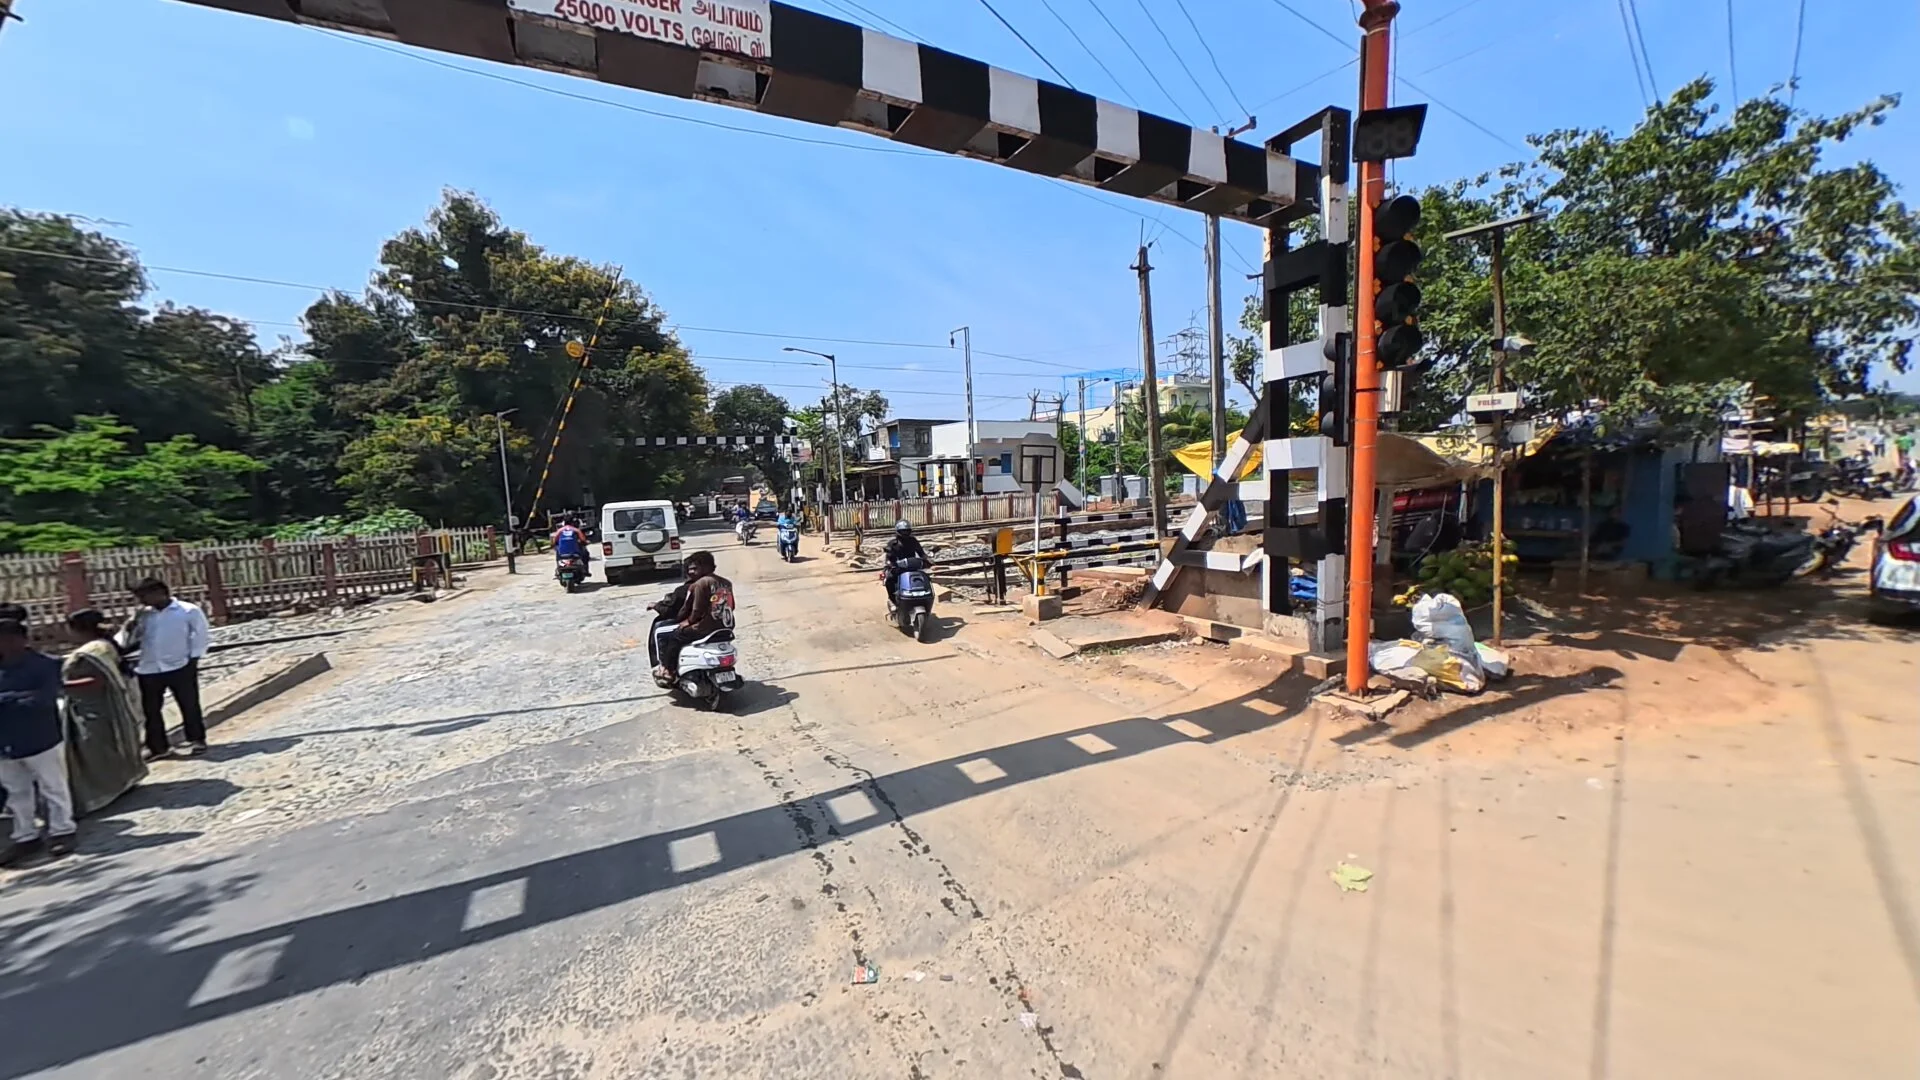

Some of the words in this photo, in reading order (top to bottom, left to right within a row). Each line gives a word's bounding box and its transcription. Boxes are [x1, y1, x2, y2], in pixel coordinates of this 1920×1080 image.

[554, 0, 616, 25] 25000
[621, 9, 684, 41] VOLTS
[692, 0, 764, 33] அபாயம்
